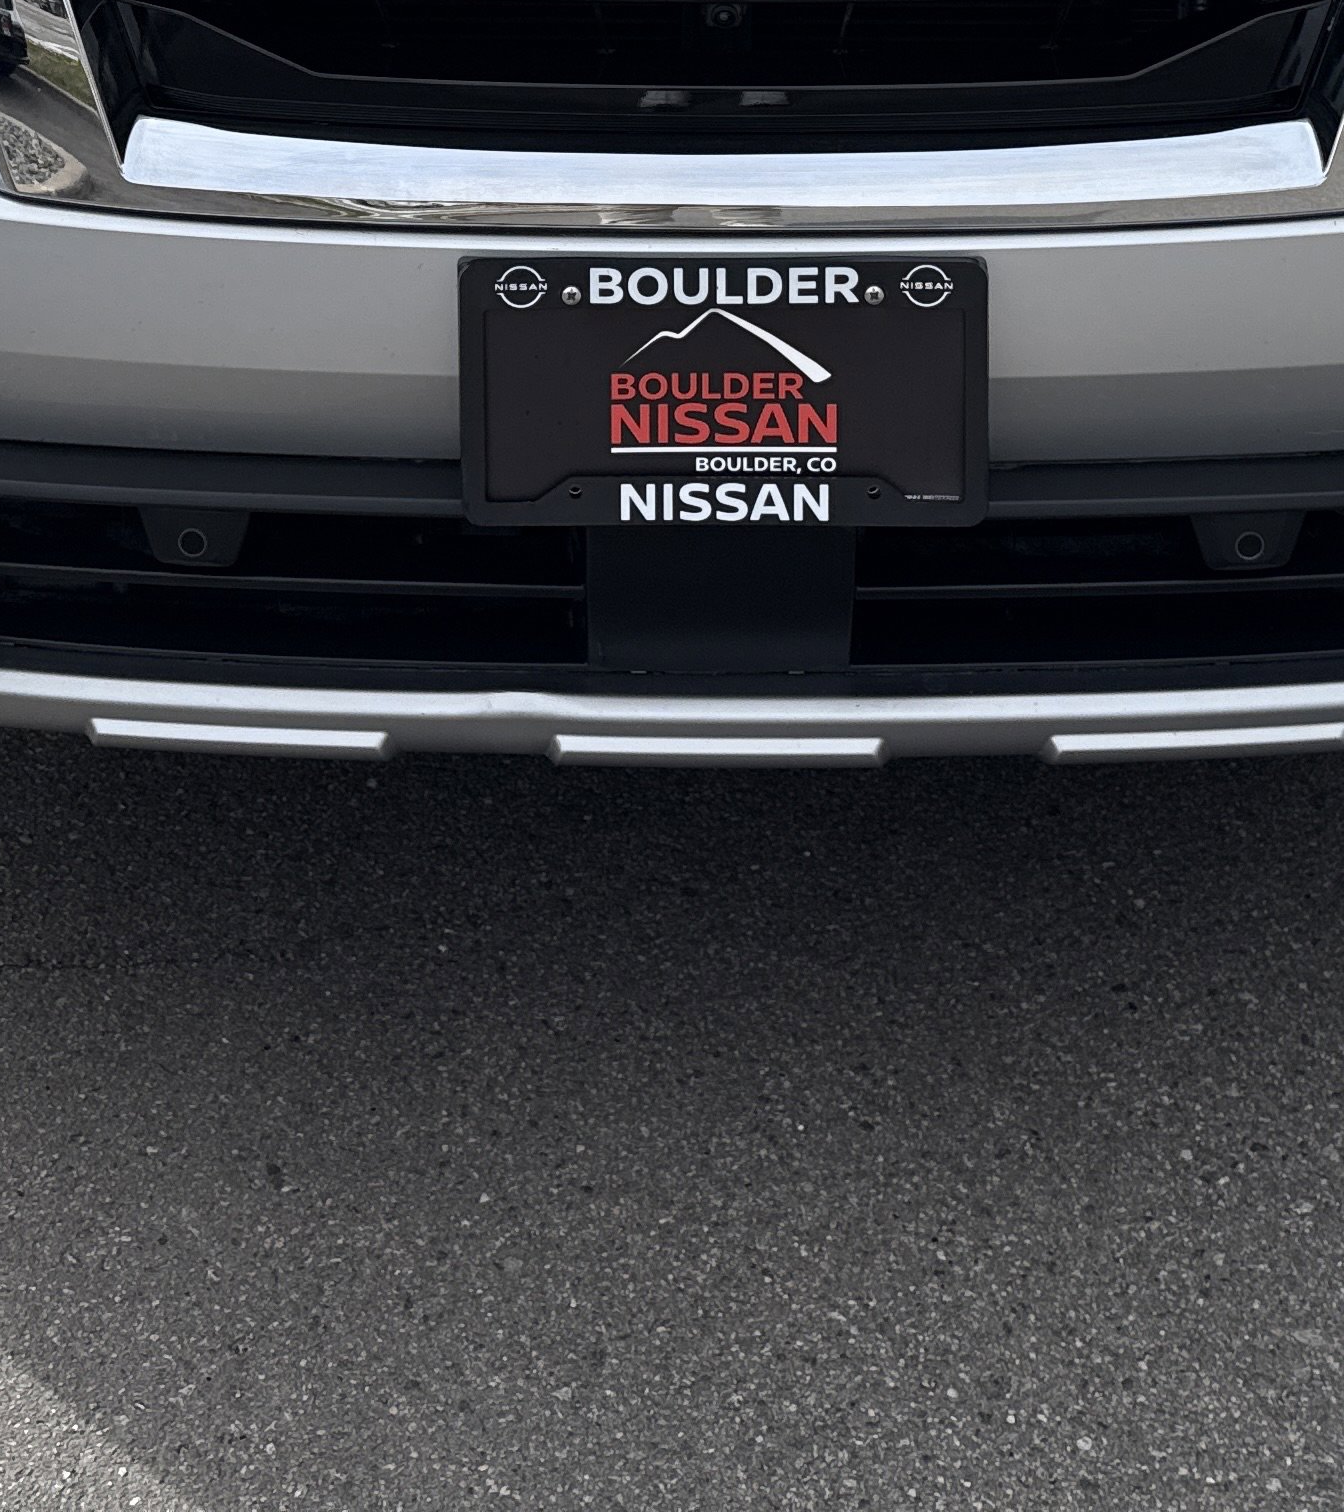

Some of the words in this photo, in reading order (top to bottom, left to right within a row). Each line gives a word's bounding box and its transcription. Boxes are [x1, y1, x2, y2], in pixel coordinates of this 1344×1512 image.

[494, 282, 548, 292] NISSAN
[589, 266, 860, 306] BOULDER
[899, 281, 954, 290] NISSAN
[610, 372, 804, 401] BOULDER
[610, 402, 838, 445] NISSAN
[695, 456, 803, 475] BOULDER,
[806, 457, 837, 472] CO
[619, 482, 830, 522] NISSAN
